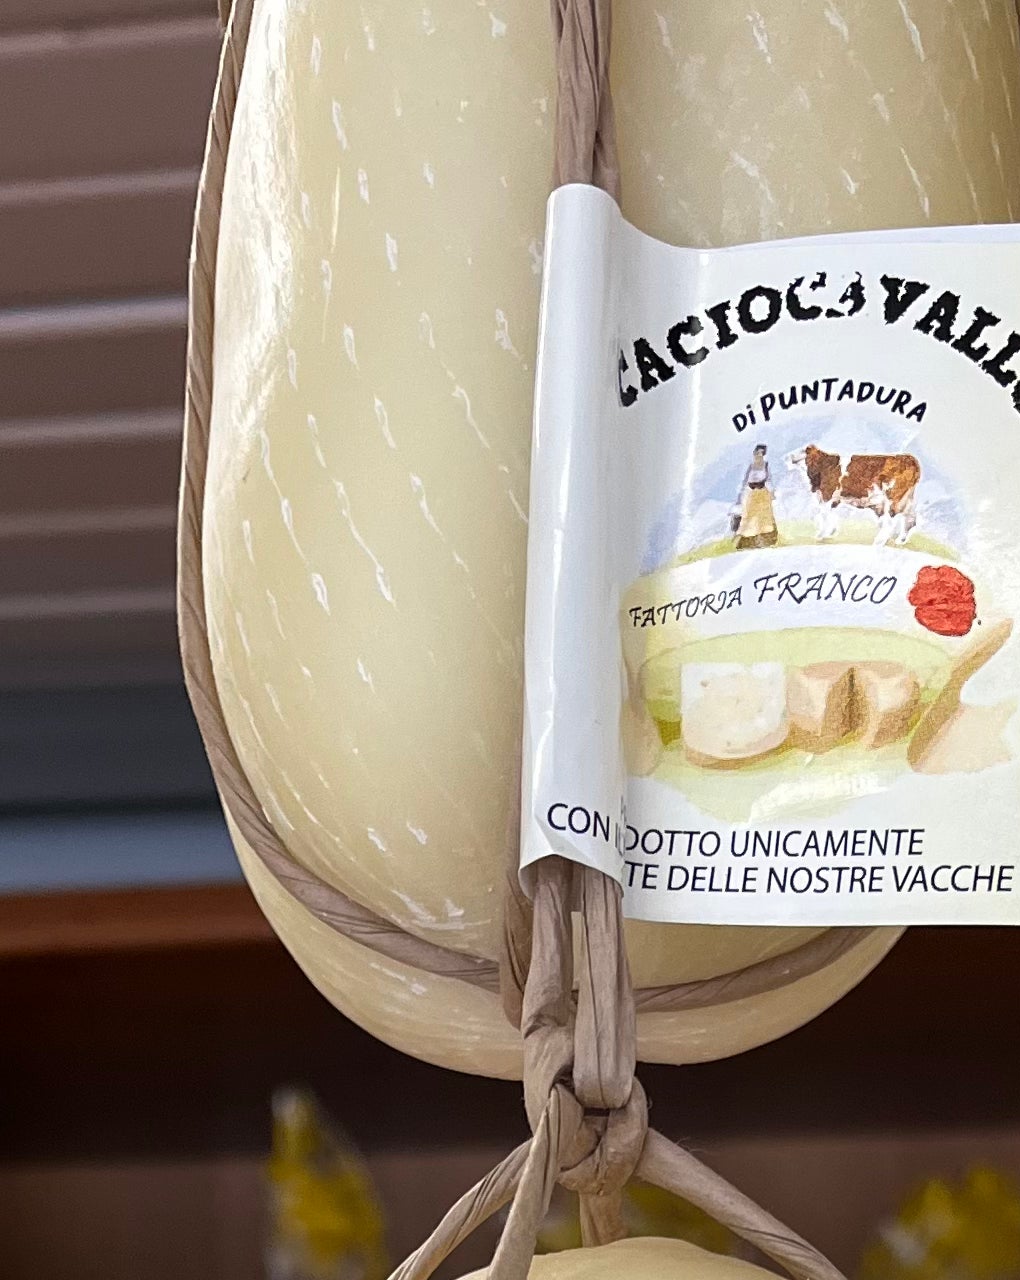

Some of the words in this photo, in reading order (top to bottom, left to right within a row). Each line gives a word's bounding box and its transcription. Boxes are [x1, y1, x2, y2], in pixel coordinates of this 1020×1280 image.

[762, 377, 928, 423] PUNTADURA
[753, 572, 898, 605] FRANCO
[546, 802, 610, 843] CON
[666, 865, 759, 893] DELLE
[766, 865, 885, 894] NOSTRE
[891, 864, 1015, 893] VACCHE
[730, 828, 926, 858] UNICAMENTE
